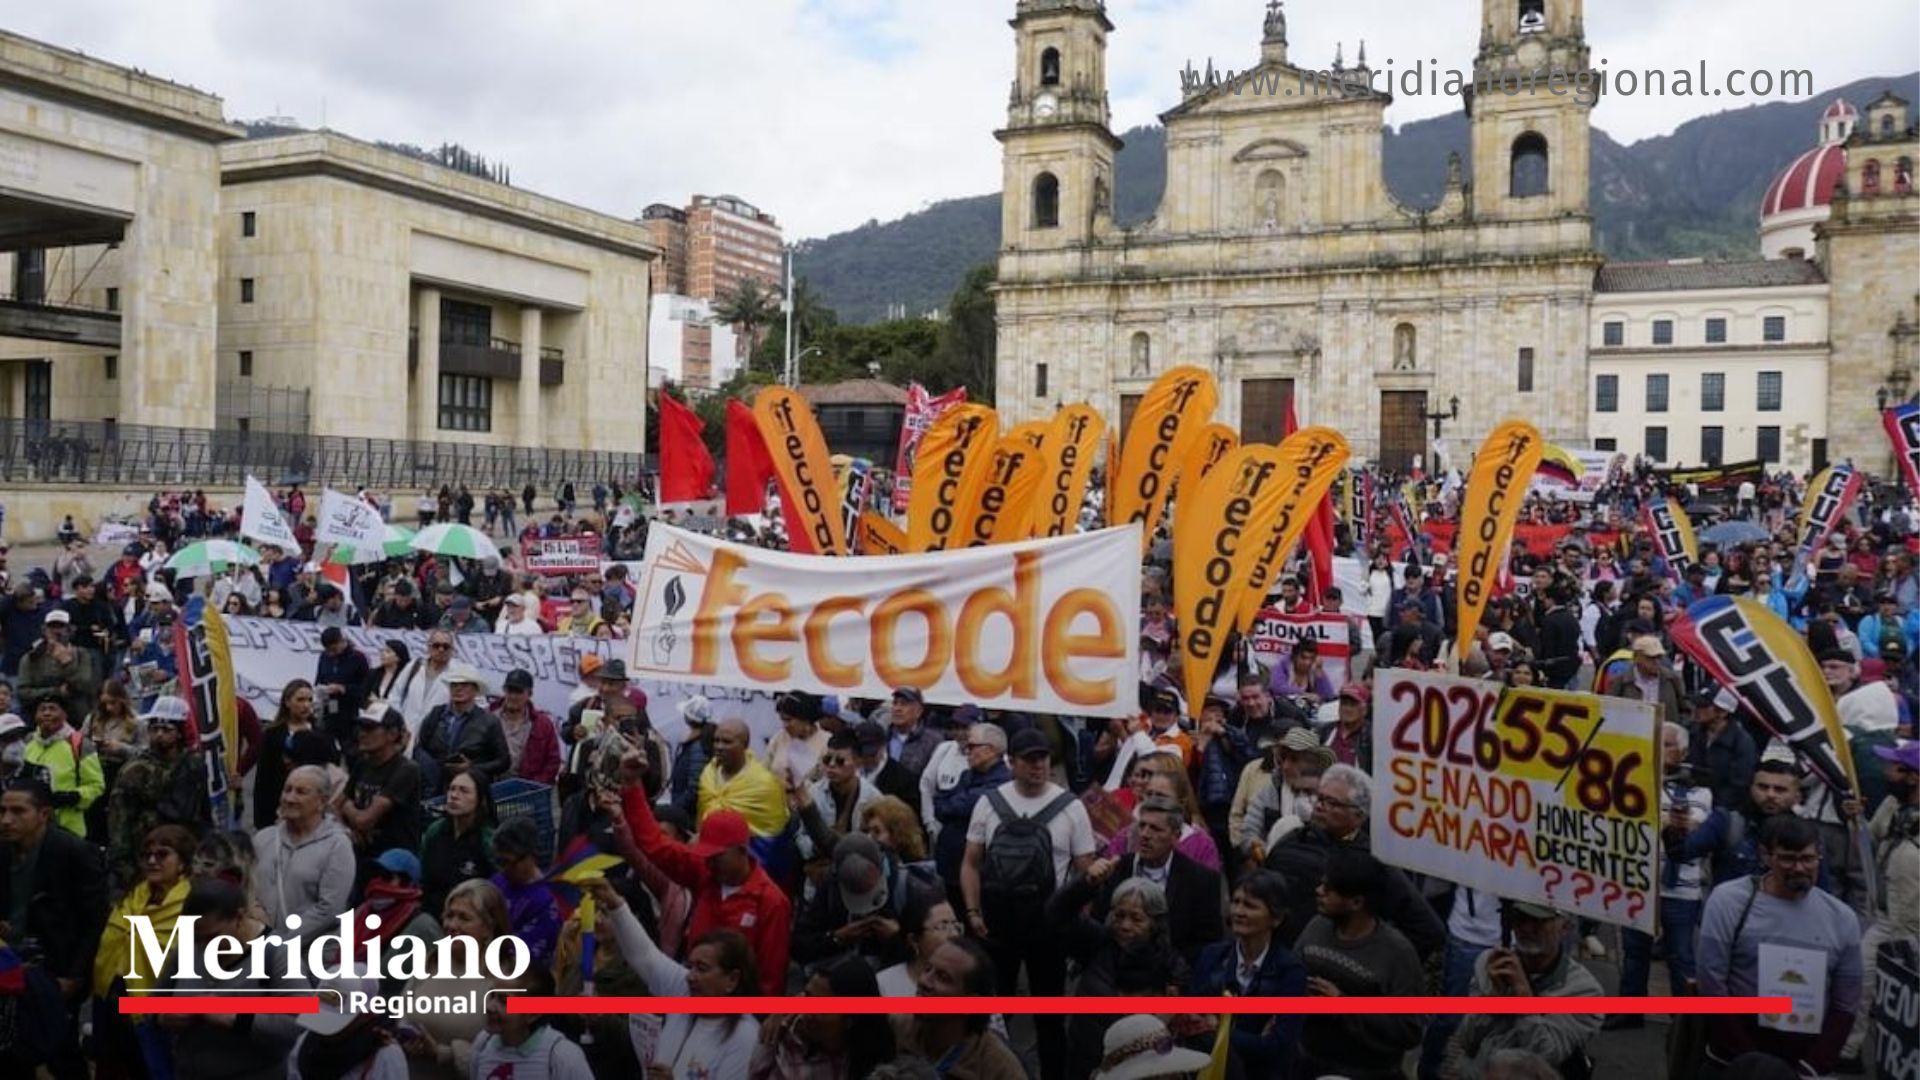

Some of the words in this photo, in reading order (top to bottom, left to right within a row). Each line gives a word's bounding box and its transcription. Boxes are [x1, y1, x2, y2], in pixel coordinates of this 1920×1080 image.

[1352, 475, 1366, 541] CUT
[1464, 436, 1530, 607] fecode
[1804, 472, 1848, 546] CUT
[1188, 461, 1275, 659] fecode
[690, 547, 1126, 706] fecode
[189, 622, 227, 794] CUT
[1391, 681, 1500, 771] 2026
[1699, 606, 1851, 793] CUT
[1391, 758, 1532, 823] SENADO
[1537, 803, 1650, 856] HONESTOS
[1535, 835, 1650, 891] DECENTES
